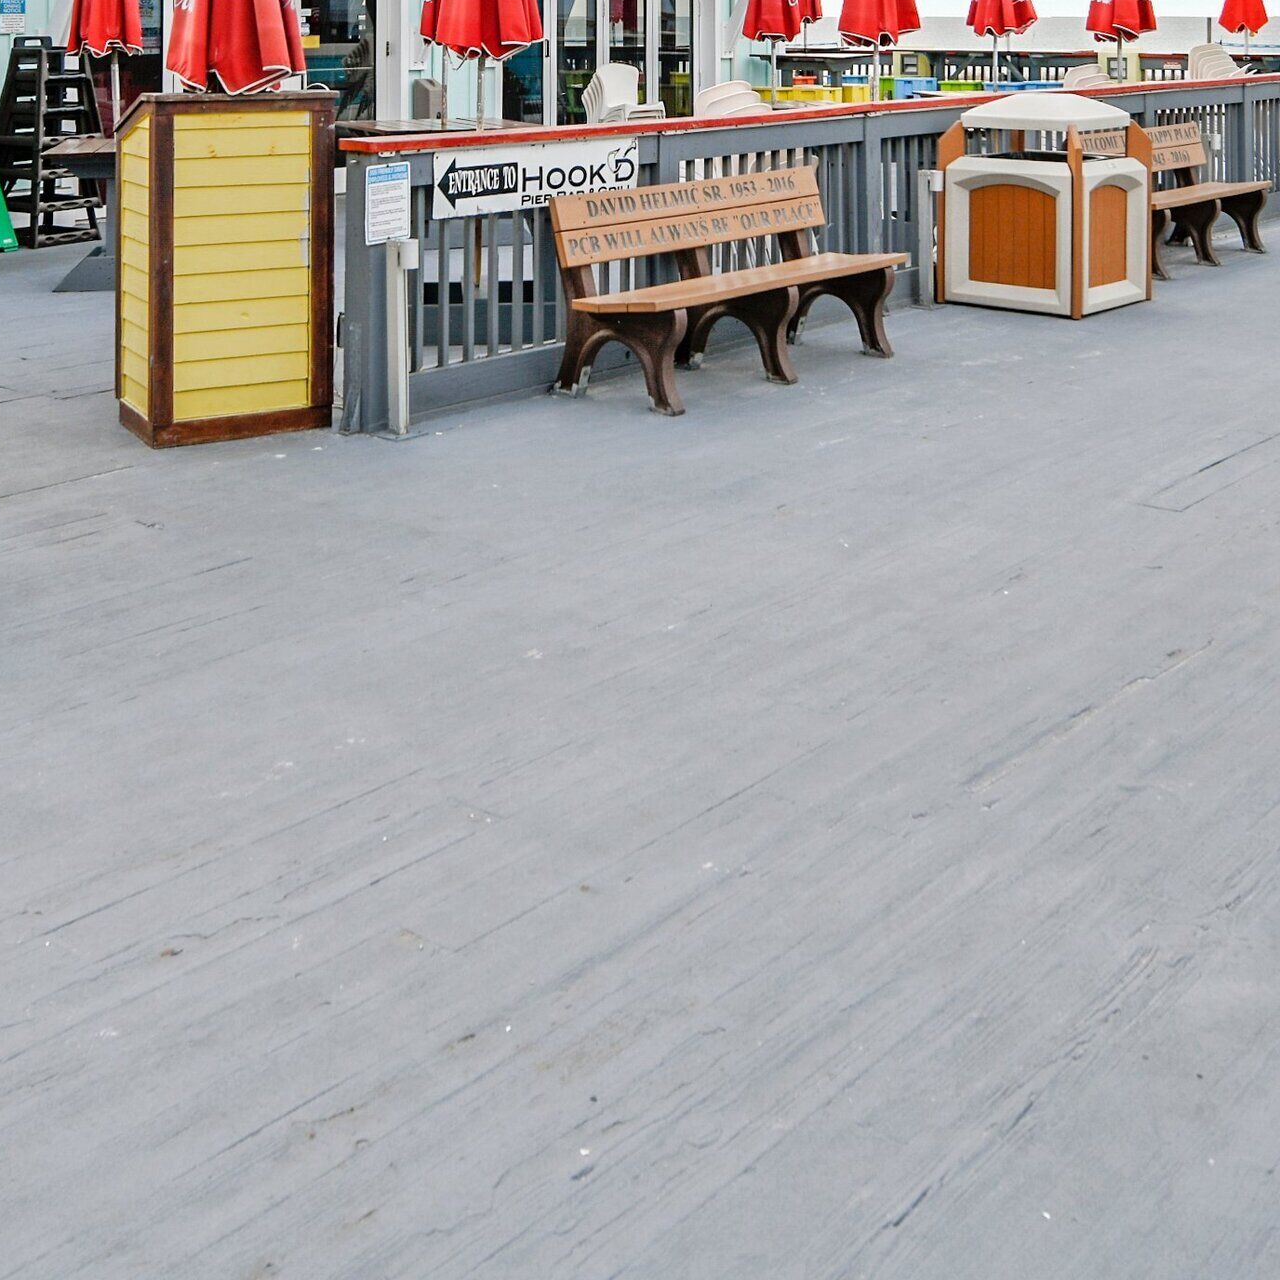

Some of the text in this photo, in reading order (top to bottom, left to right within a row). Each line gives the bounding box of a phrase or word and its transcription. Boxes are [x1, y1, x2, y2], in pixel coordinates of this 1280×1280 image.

[1081, 133, 1118, 151] ELCOME
[448, 166, 499, 196] ENTRANCE
[503, 165, 516, 189] TO
[521, 193, 553, 206] PIER
[586, 195, 637, 218] DAVID
[641, 186, 700, 211] HELMIC
[702, 182, 727, 203] SR.
[730, 180, 755, 200] 1953
[767, 175, 796, 194] 2016
[568, 201, 820, 257] PCB WILL ALWAYS BE "OUR PLACE"
